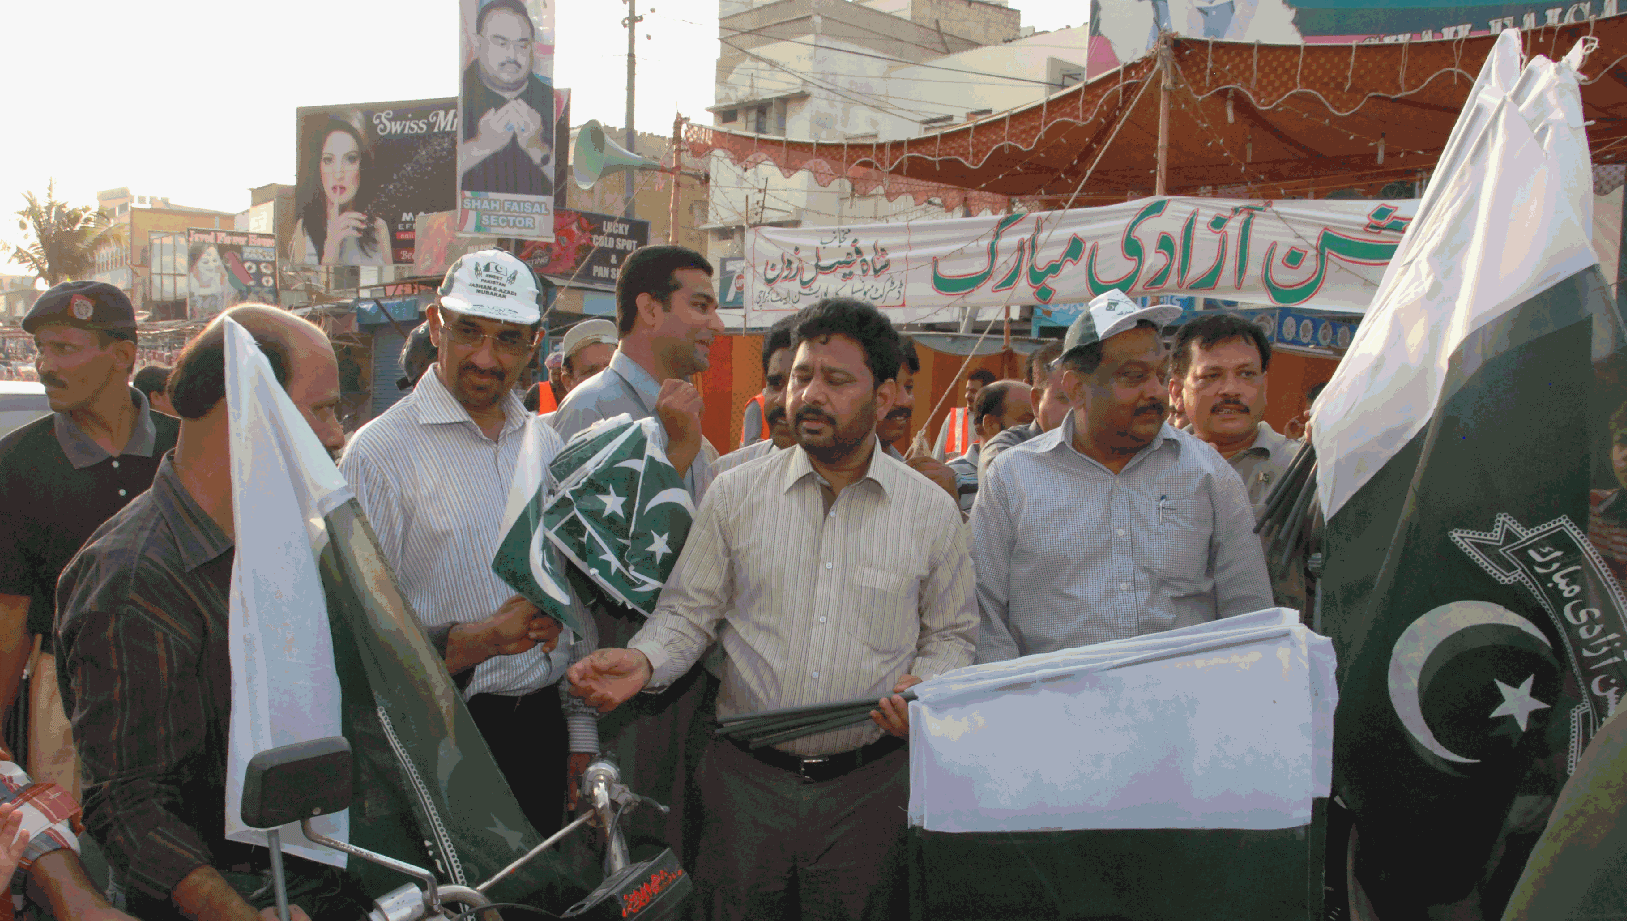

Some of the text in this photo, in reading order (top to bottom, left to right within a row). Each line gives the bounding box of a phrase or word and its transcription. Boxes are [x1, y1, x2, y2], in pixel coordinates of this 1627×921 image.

[373, 110, 428, 136] Swiss
[462, 198, 549, 215] SHAH FAISAL
[481, 214, 534, 229] SECTOR
[602, 220, 630, 236] LUCKY
[592, 234, 638, 252] COLD SPOT
[1086, 199, 1274, 298] آزادی
[610, 253, 618, 265] &
[931, 211, 1087, 305] مبارک
[592, 265, 609, 279] PAN
